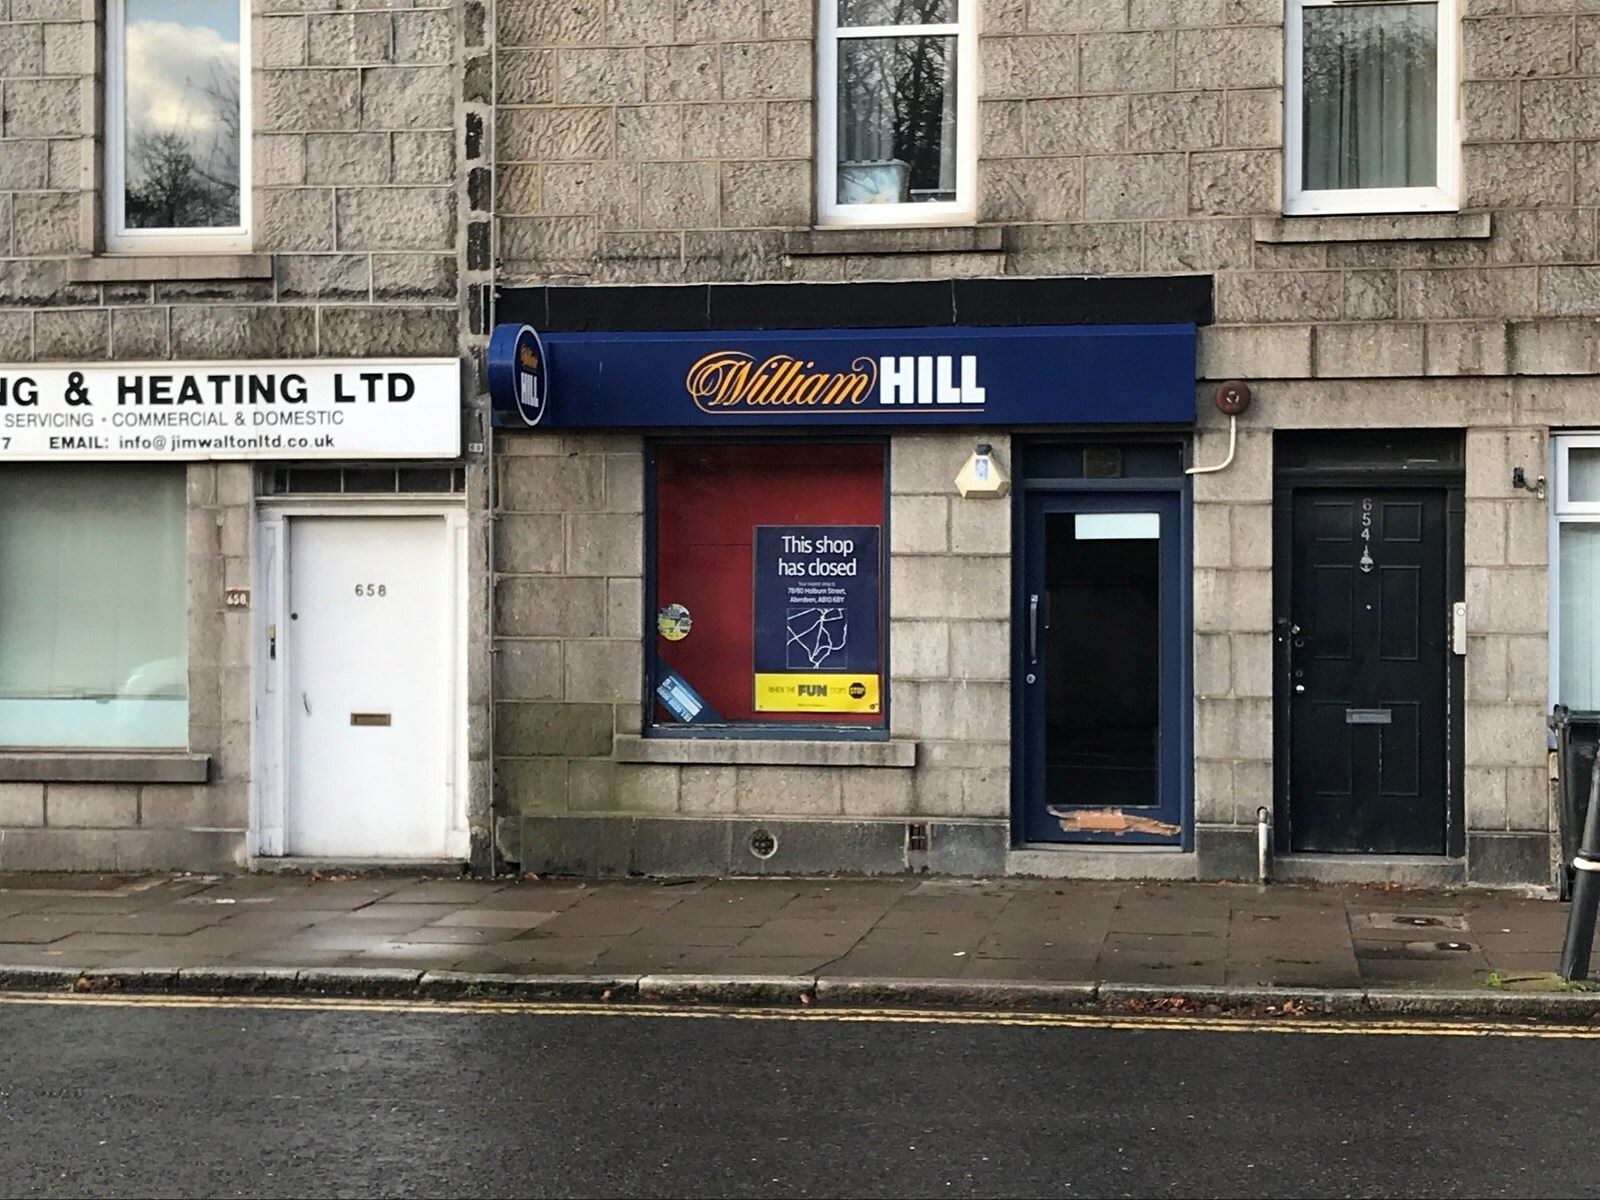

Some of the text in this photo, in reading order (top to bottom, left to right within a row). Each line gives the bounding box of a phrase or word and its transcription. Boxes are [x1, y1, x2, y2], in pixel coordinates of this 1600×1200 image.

[686, 351, 985, 406] William HILL
[0, 371, 415, 407] G & HEATING LTD
[4, 410, 344, 428] SERVICING COMMERCIAL & DOMESTIC
[50, 436, 109, 450] EMAIL:
[119, 434, 335, 452] info@jimwaltonltd.co.uk
[1361, 498, 1372, 541] 654
[781, 535, 854, 557] This shop
[778, 557, 857, 576] has closed
[355, 584, 387, 597] 658
[798, 685, 827, 697] FUN
[850, 687, 865, 695] STOP
